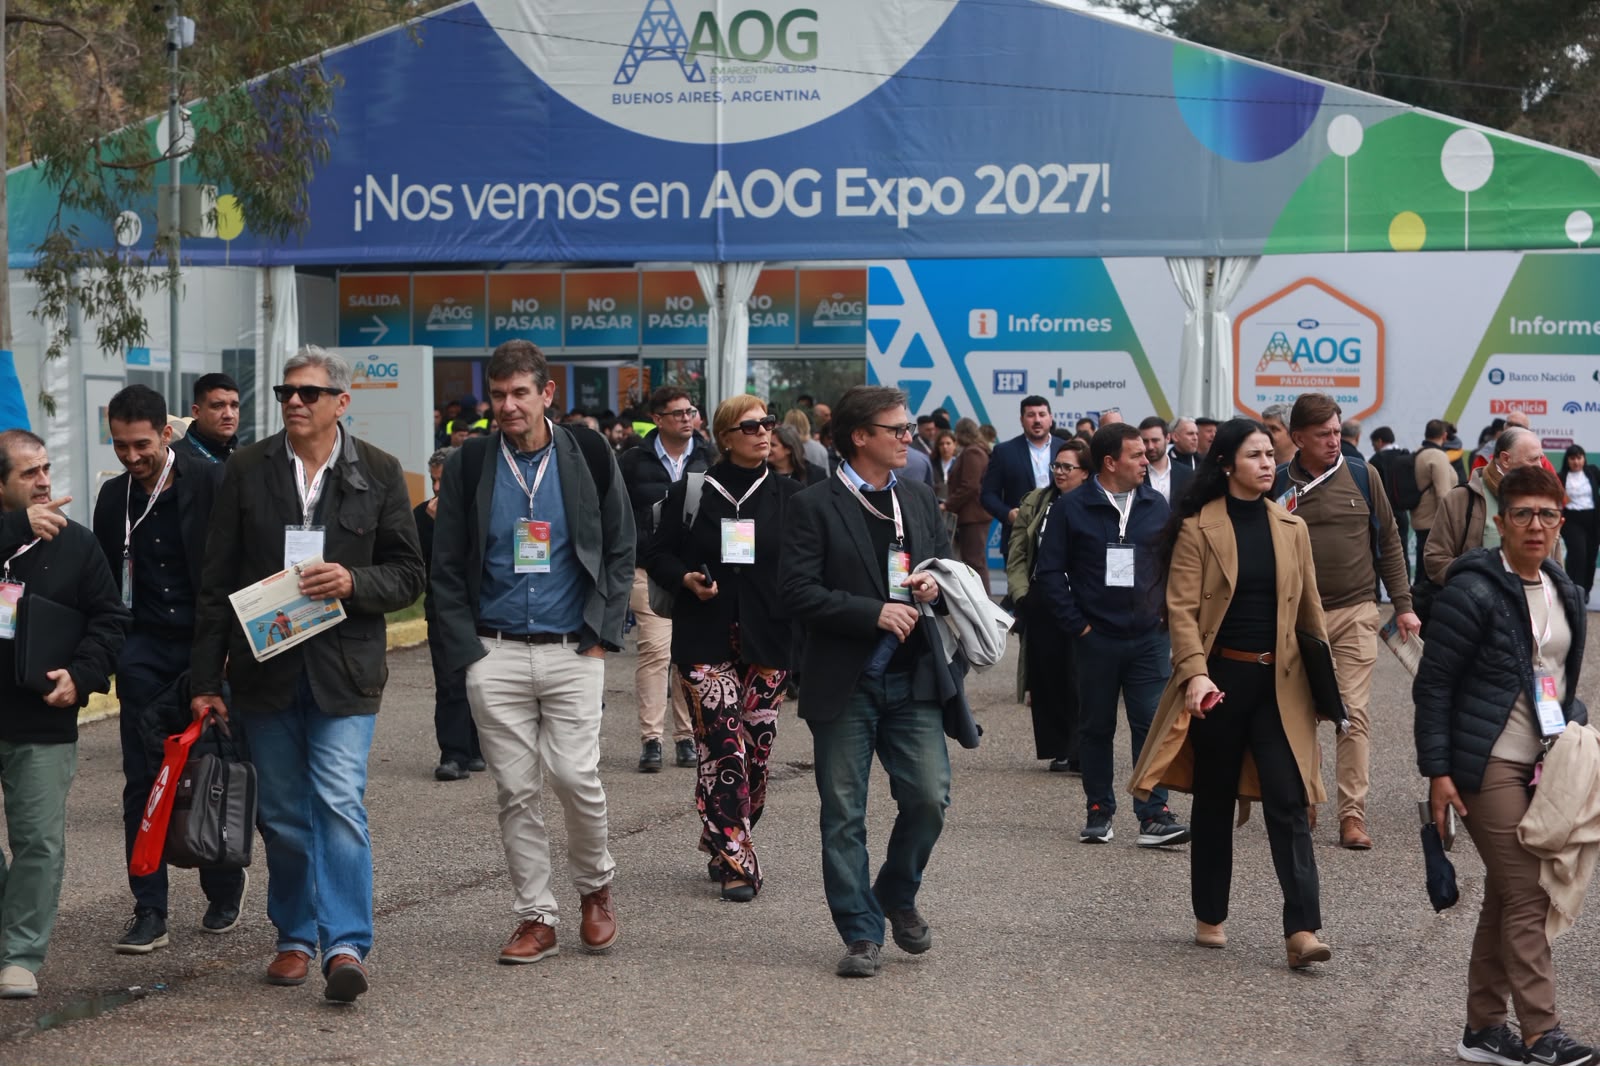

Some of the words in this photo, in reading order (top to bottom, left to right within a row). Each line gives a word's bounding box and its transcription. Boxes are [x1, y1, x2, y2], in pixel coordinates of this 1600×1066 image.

[612, 92, 673, 105] BUENOS
[677, 91, 727, 105] AIRES,
[731, 89, 821, 103] ARGENTINA
[354, 173, 453, 231] ¡Nos
[461, 182, 621, 220] vemos
[630, 181, 690, 219] en
[700, 168, 822, 218] AOG
[836, 168, 965, 228] Expo
[975, 163, 1110, 214] 2027!
[348, 295, 400, 307] SALIDA
[511, 299, 539, 313] NO
[587, 298, 616, 312] NO
[665, 296, 693, 311] NO
[830, 301, 863, 315] AOG
[495, 316, 555, 330] PASAR
[571, 315, 632, 330] PASAR
[648, 314, 708, 328] PASAR
[748, 313, 789, 327] SAR
[1008, 314, 1112, 332] Informes
[1292, 337, 1361, 364] AOG
[366, 363, 398, 377] AOG
[1509, 372, 1538, 381] Banco
[1541, 372, 1576, 381] Nación
[1072, 379, 1126, 390] pluspetrol
[1280, 377, 1335, 386] PATAGONIA
[1508, 401, 1545, 413] Galicia
